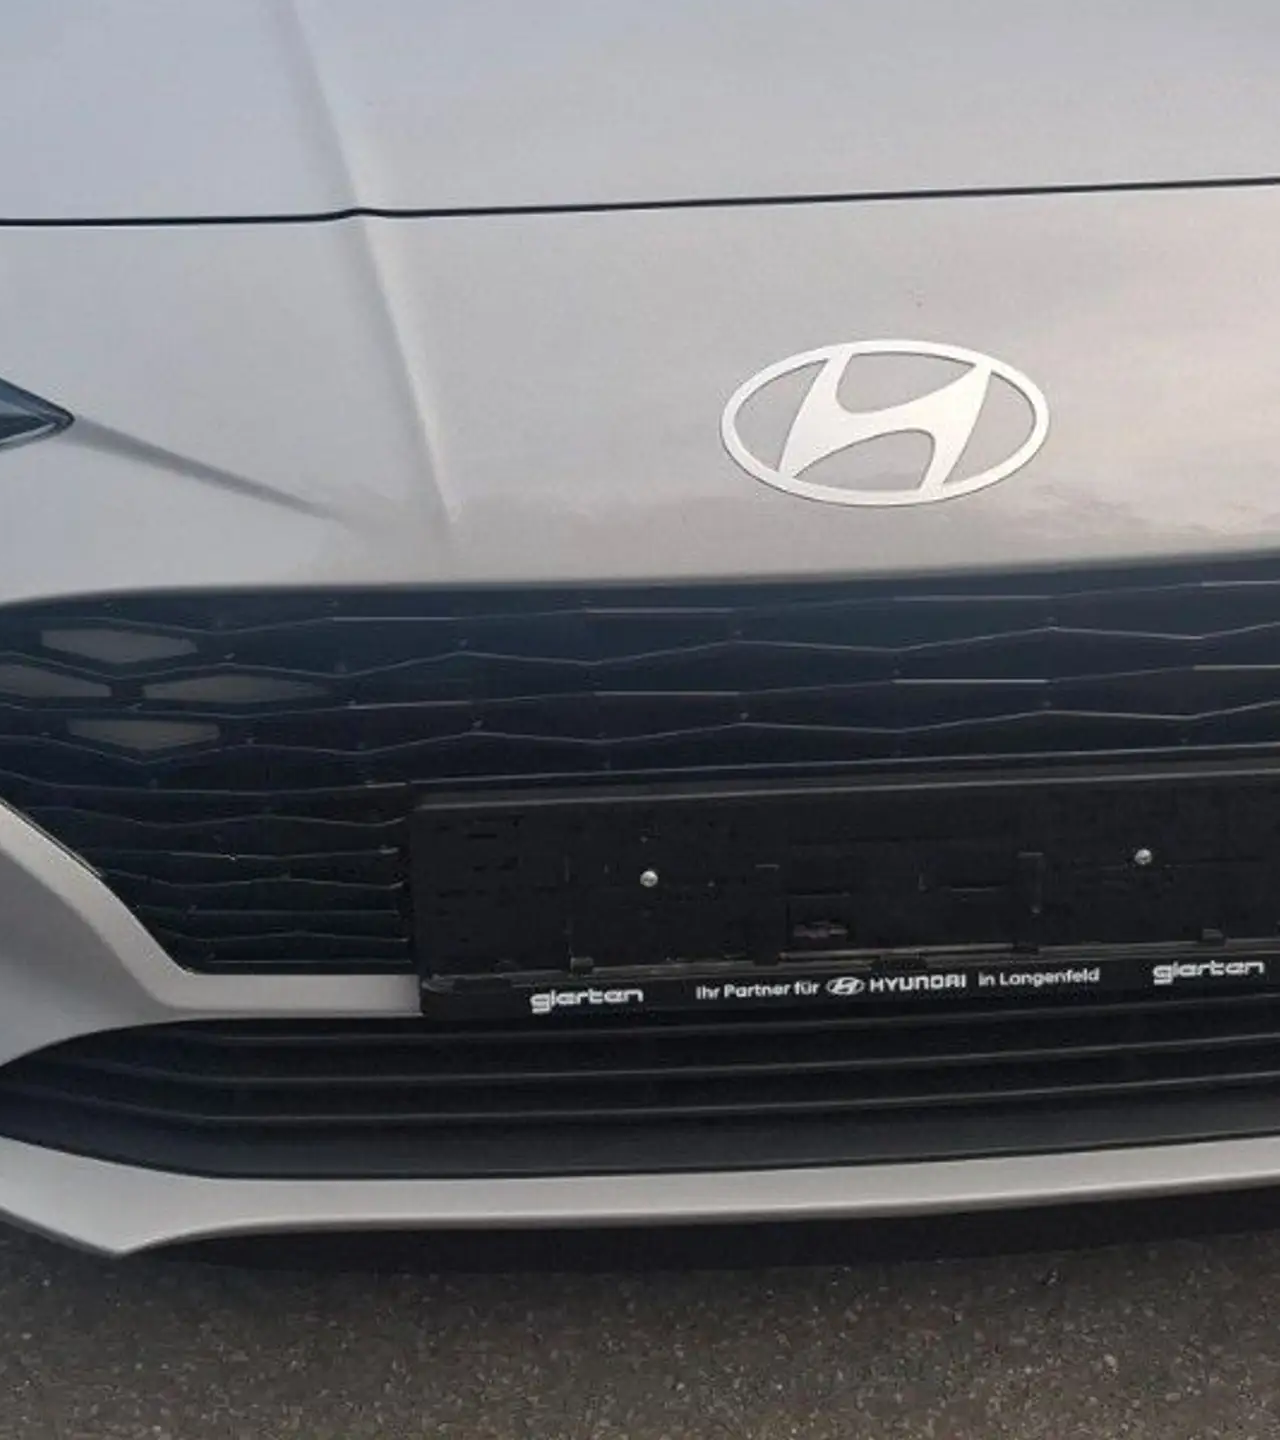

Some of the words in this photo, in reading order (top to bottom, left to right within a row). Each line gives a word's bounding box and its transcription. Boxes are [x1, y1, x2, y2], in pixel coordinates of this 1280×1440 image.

[695, 985, 721, 1001] Ihr
[723, 982, 791, 999] Partner
[793, 980, 821, 996] für
[869, 972, 968, 993] HYUNDAI
[977, 971, 997, 988] in
[999, 966, 1101, 989] Langenfeld
